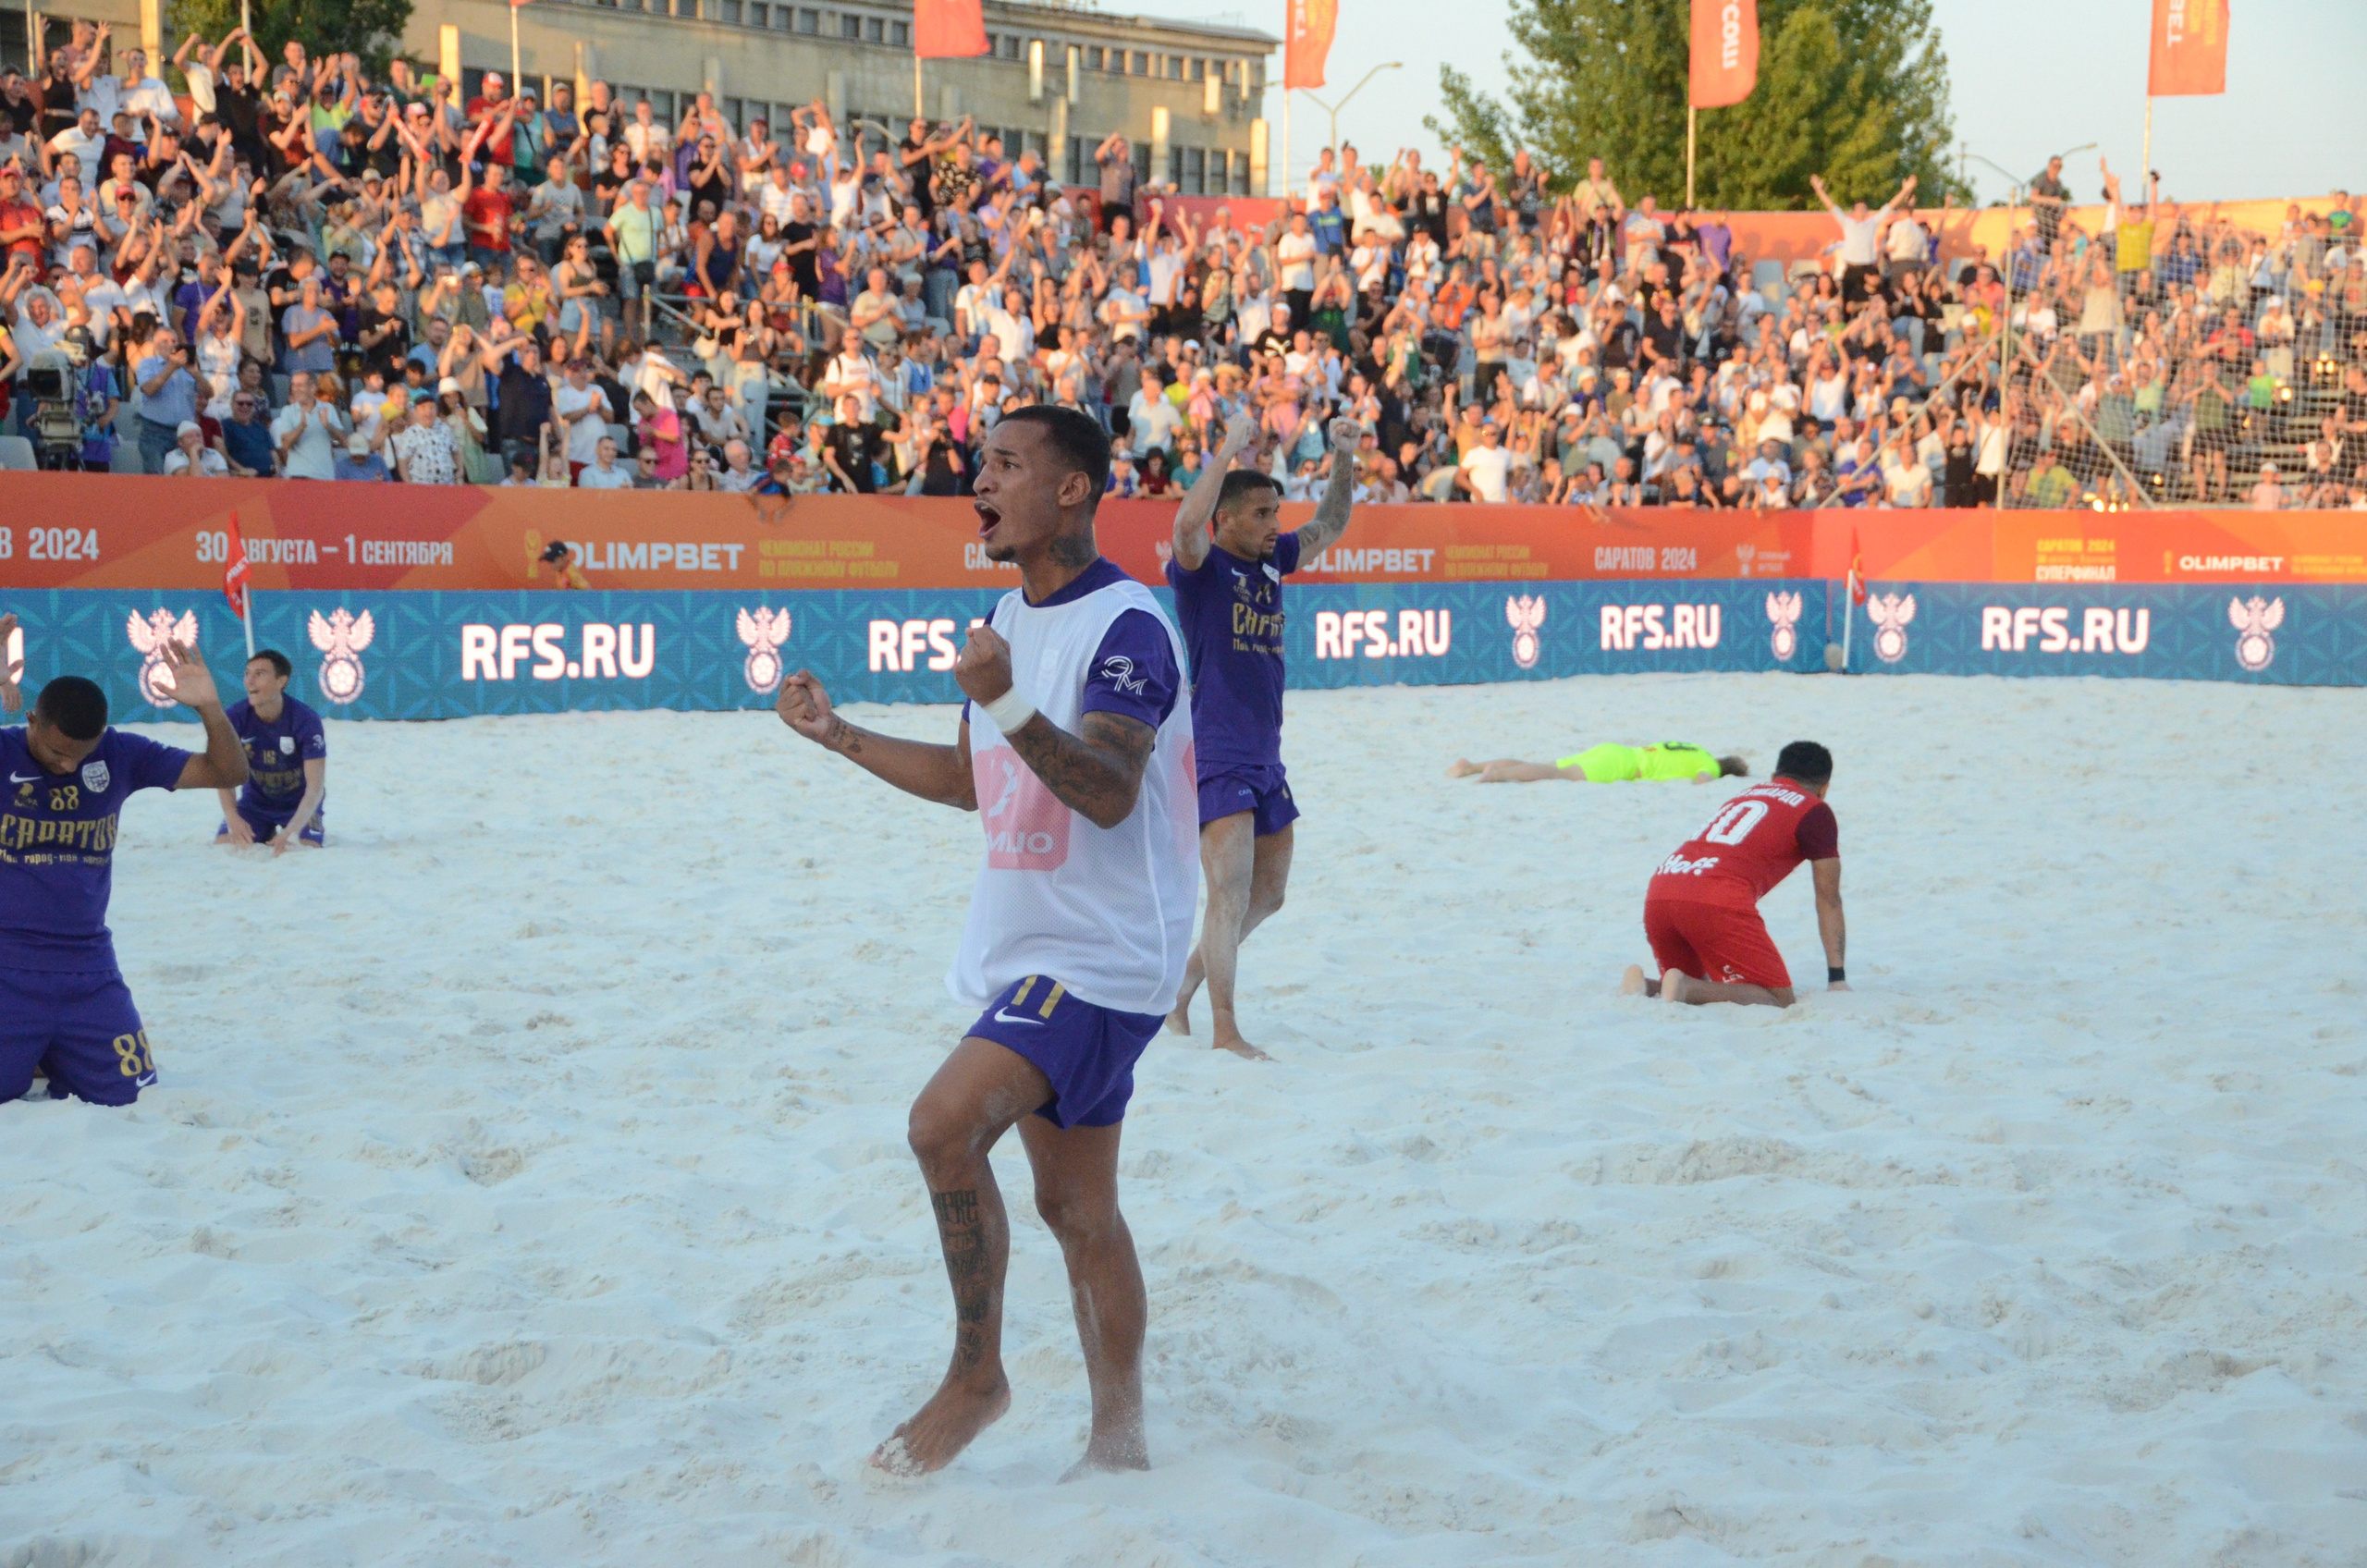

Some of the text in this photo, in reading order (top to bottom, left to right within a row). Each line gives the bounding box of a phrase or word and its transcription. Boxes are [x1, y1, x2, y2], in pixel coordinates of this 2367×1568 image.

[29, 528, 99, 559] 2024
[196, 531, 228, 562] 30
[362, 541, 454, 565] СЕНТЯБРЯ
[1594, 546, 1698, 571] САРАТОВ 2024
[2036, 565, 2116, 581] СУПЕРФИНАЛ
[2179, 556, 2284, 571] OLIMPBET
[1316, 609, 1451, 659] RFS.RU
[1600, 604, 1721, 651] RFS.RU
[1981, 606, 2149, 654] RFS.RU
[462, 624, 655, 680] RFS.RU
[49, 785, 80, 811] 88
